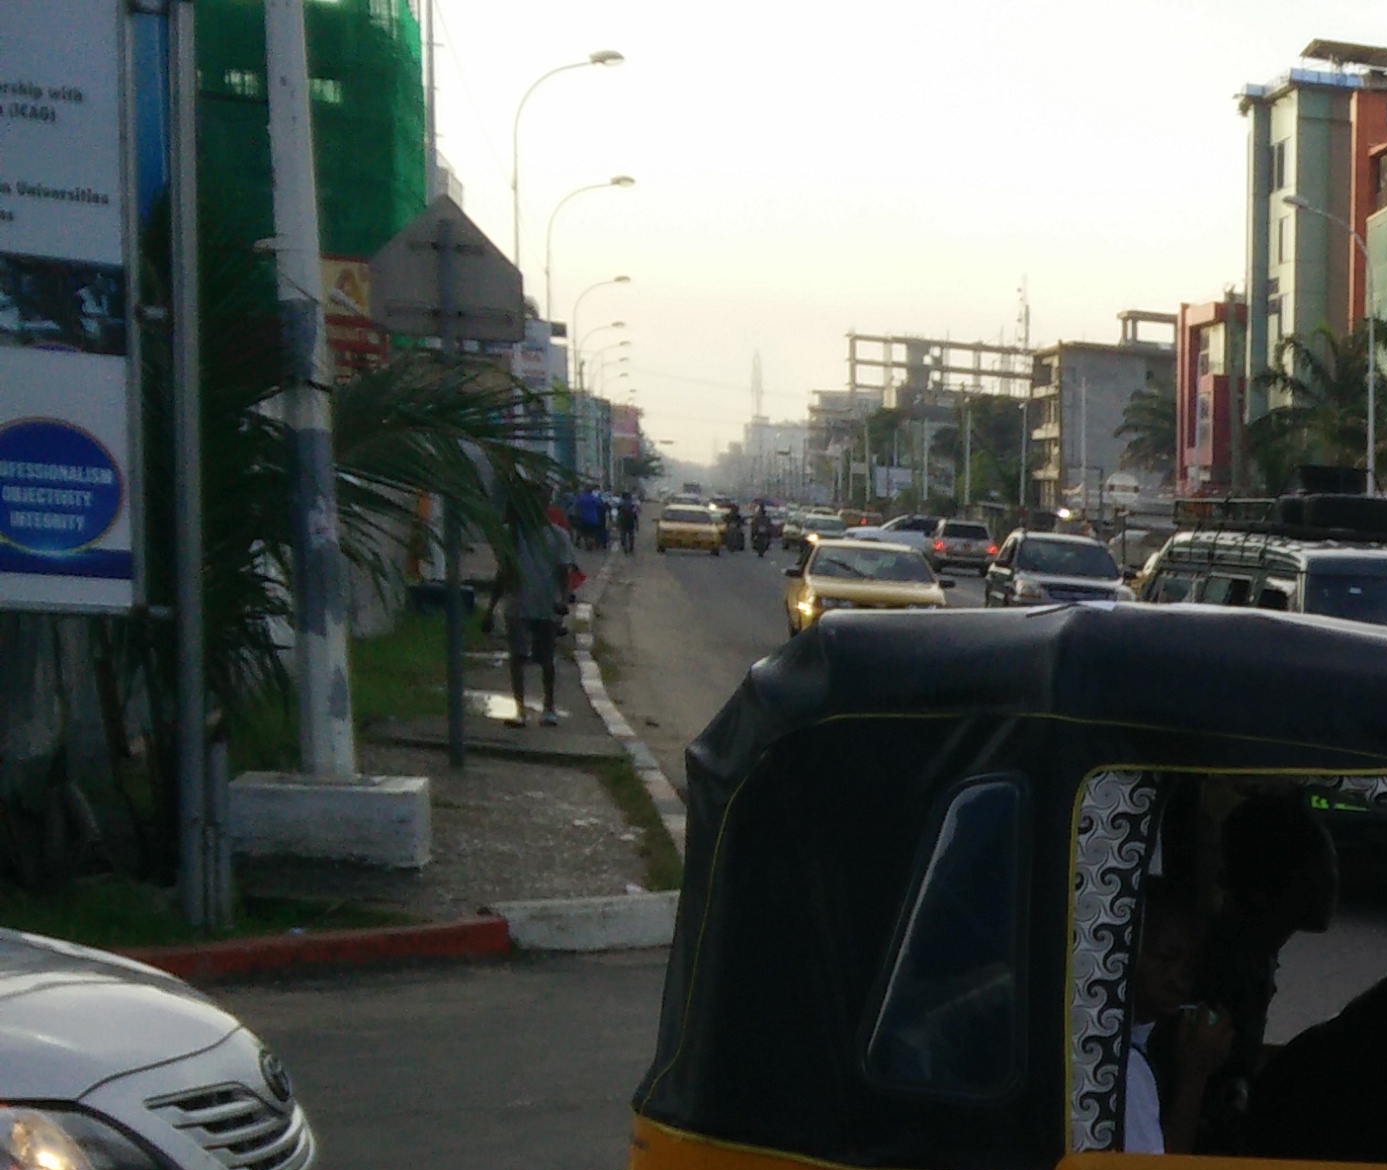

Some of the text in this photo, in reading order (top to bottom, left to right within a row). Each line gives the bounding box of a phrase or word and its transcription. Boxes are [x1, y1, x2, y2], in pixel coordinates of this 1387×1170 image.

[48, 86, 83, 103] with
[16, 180, 109, 204] Universities
[2, 485, 92, 507] OBJECTIVITY
[10, 510, 85, 531] INTEGRITY
